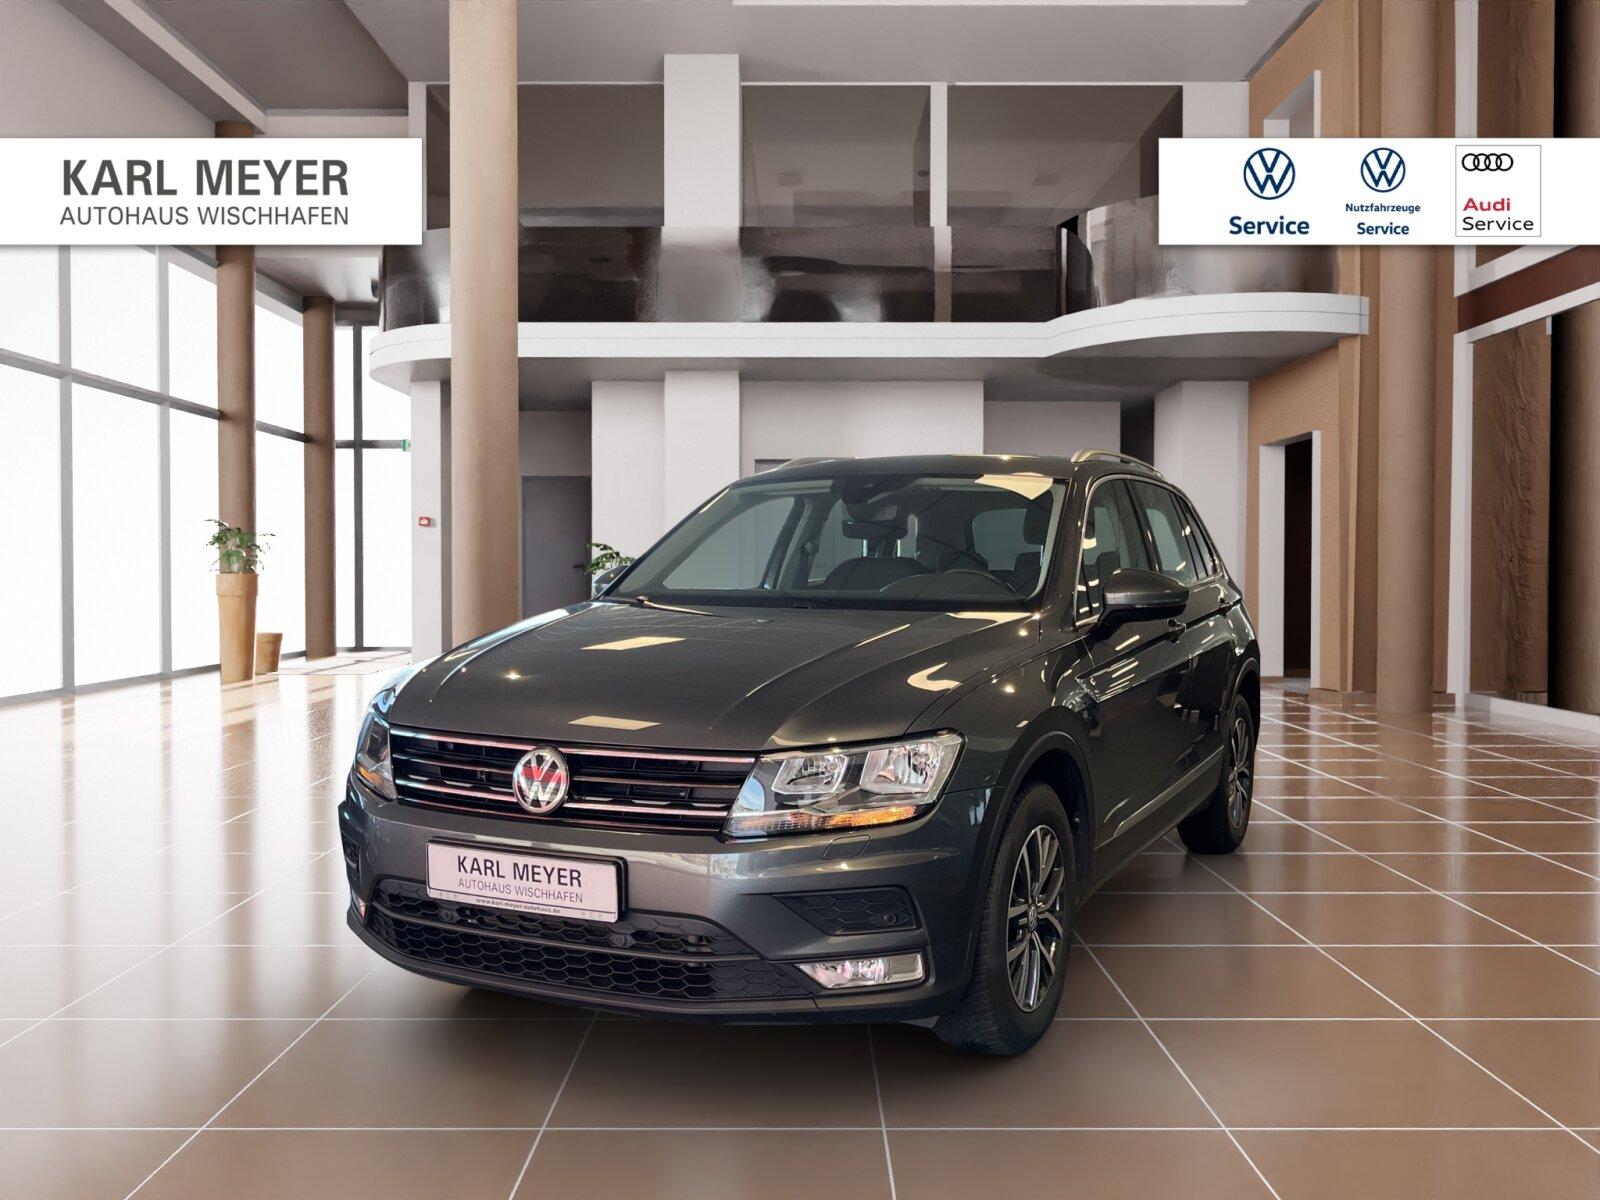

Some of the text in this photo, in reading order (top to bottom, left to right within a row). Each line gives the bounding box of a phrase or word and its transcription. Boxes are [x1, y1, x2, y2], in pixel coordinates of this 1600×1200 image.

[457, 855, 582, 887] KARL MEYER
[458, 878, 511, 895] AUTOHAUS
[515, 886, 583, 903] WISCHHAFEN
[476, 897, 561, 914] www.karl-meyer-autohaus.de
